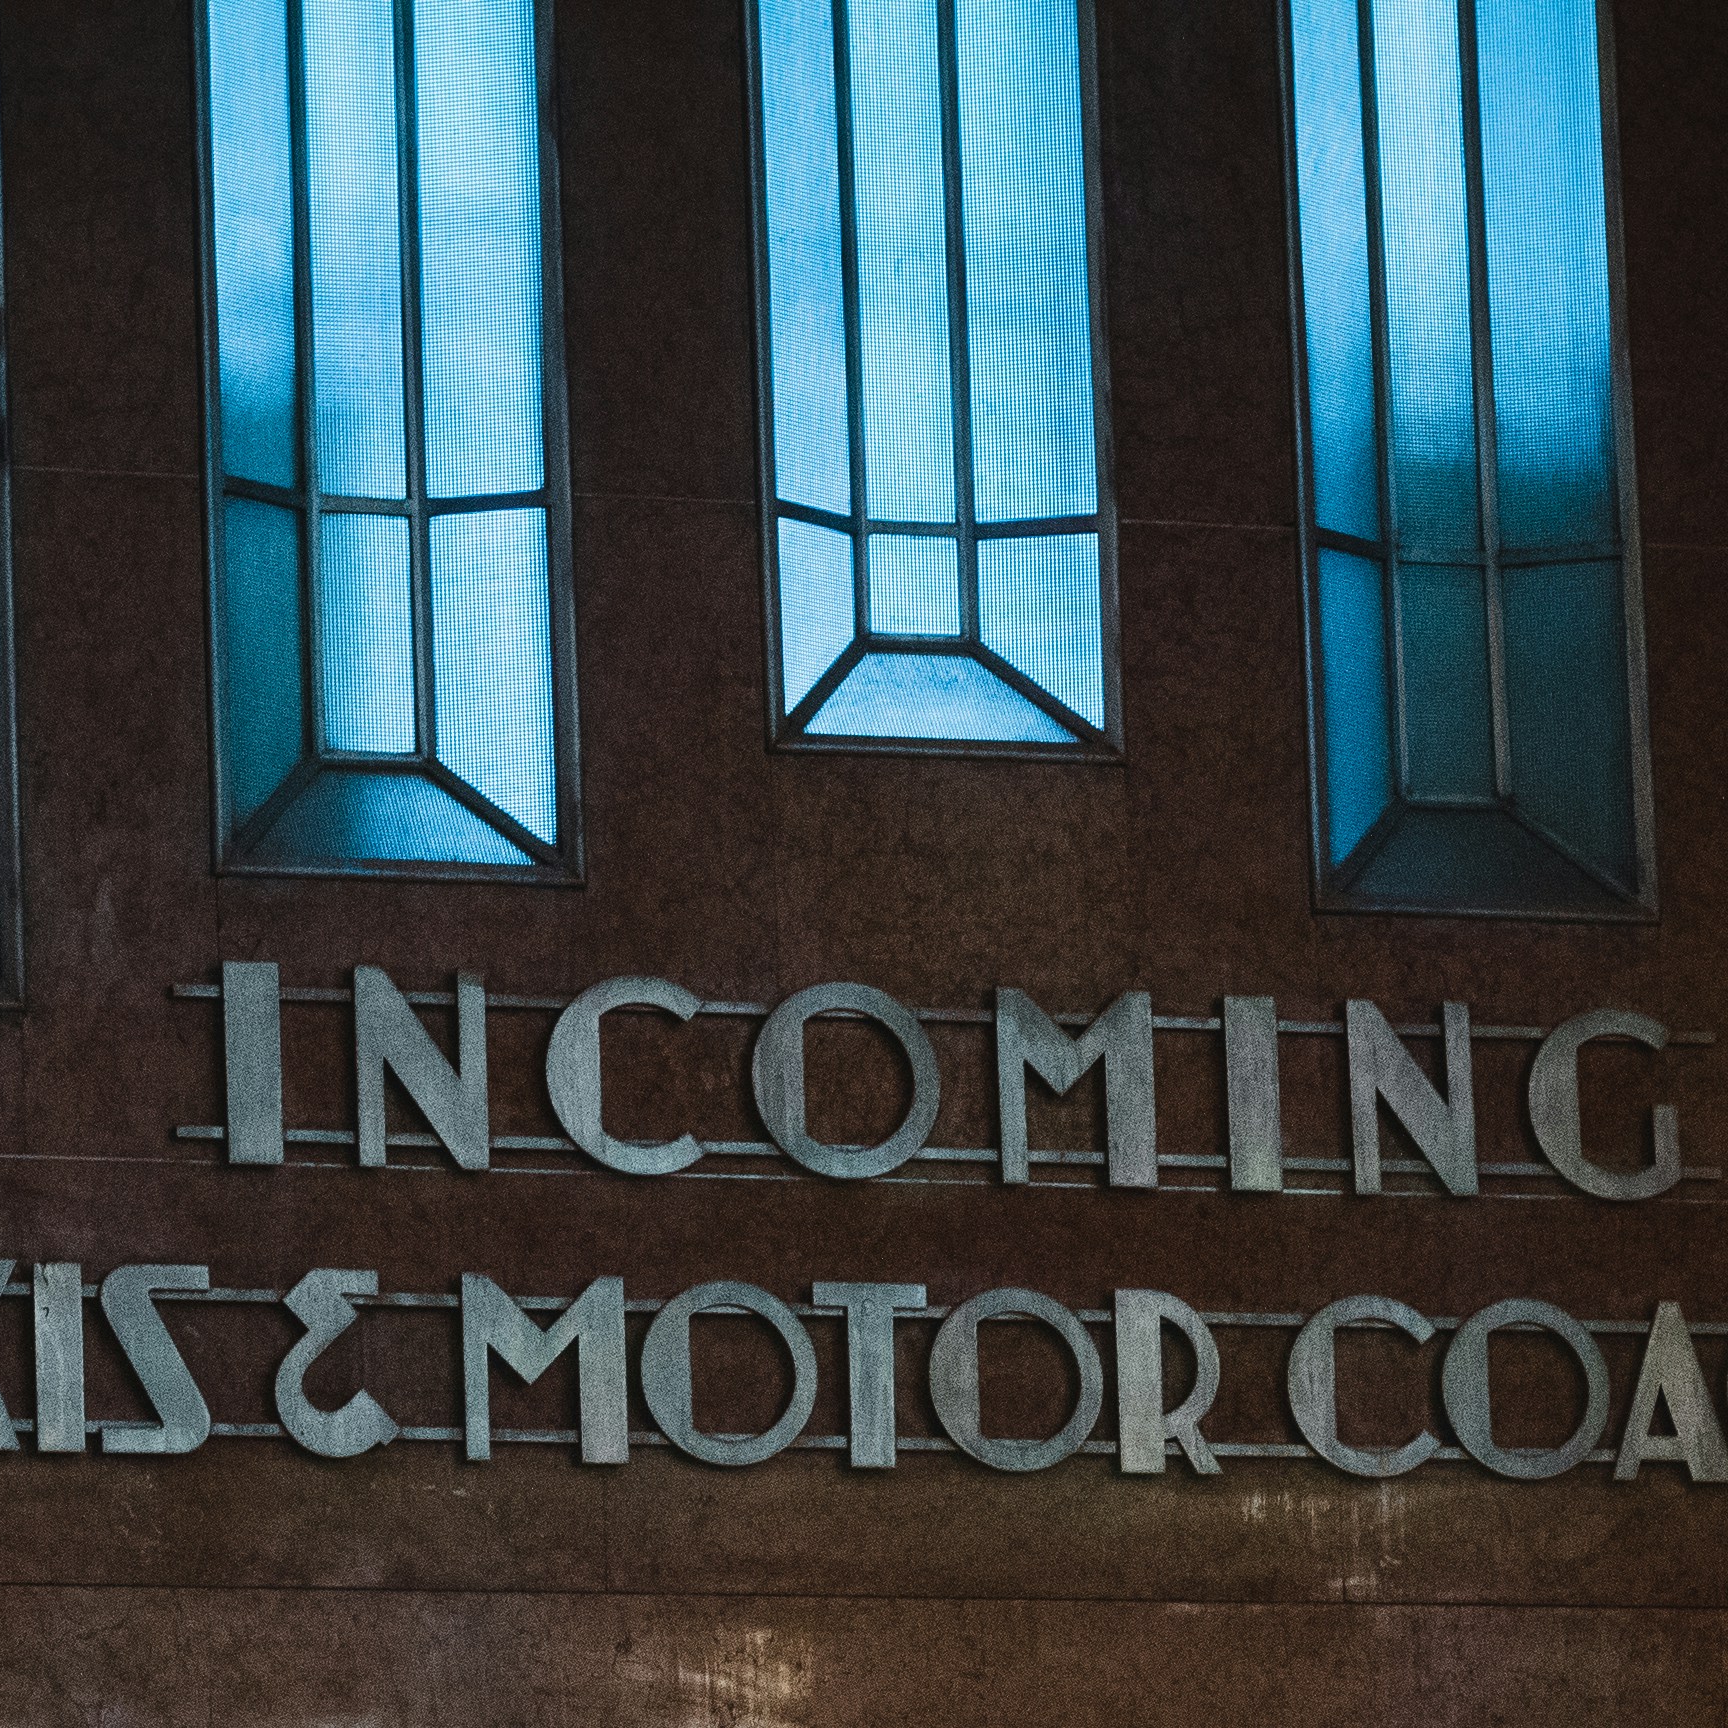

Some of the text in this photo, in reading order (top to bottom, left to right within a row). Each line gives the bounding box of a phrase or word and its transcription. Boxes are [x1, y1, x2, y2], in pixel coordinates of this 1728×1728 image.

[222, 960, 1682, 1200] INCOMING
[274, 1268, 401, 1459] &
[461, 1272, 1223, 1474] MOTOR
